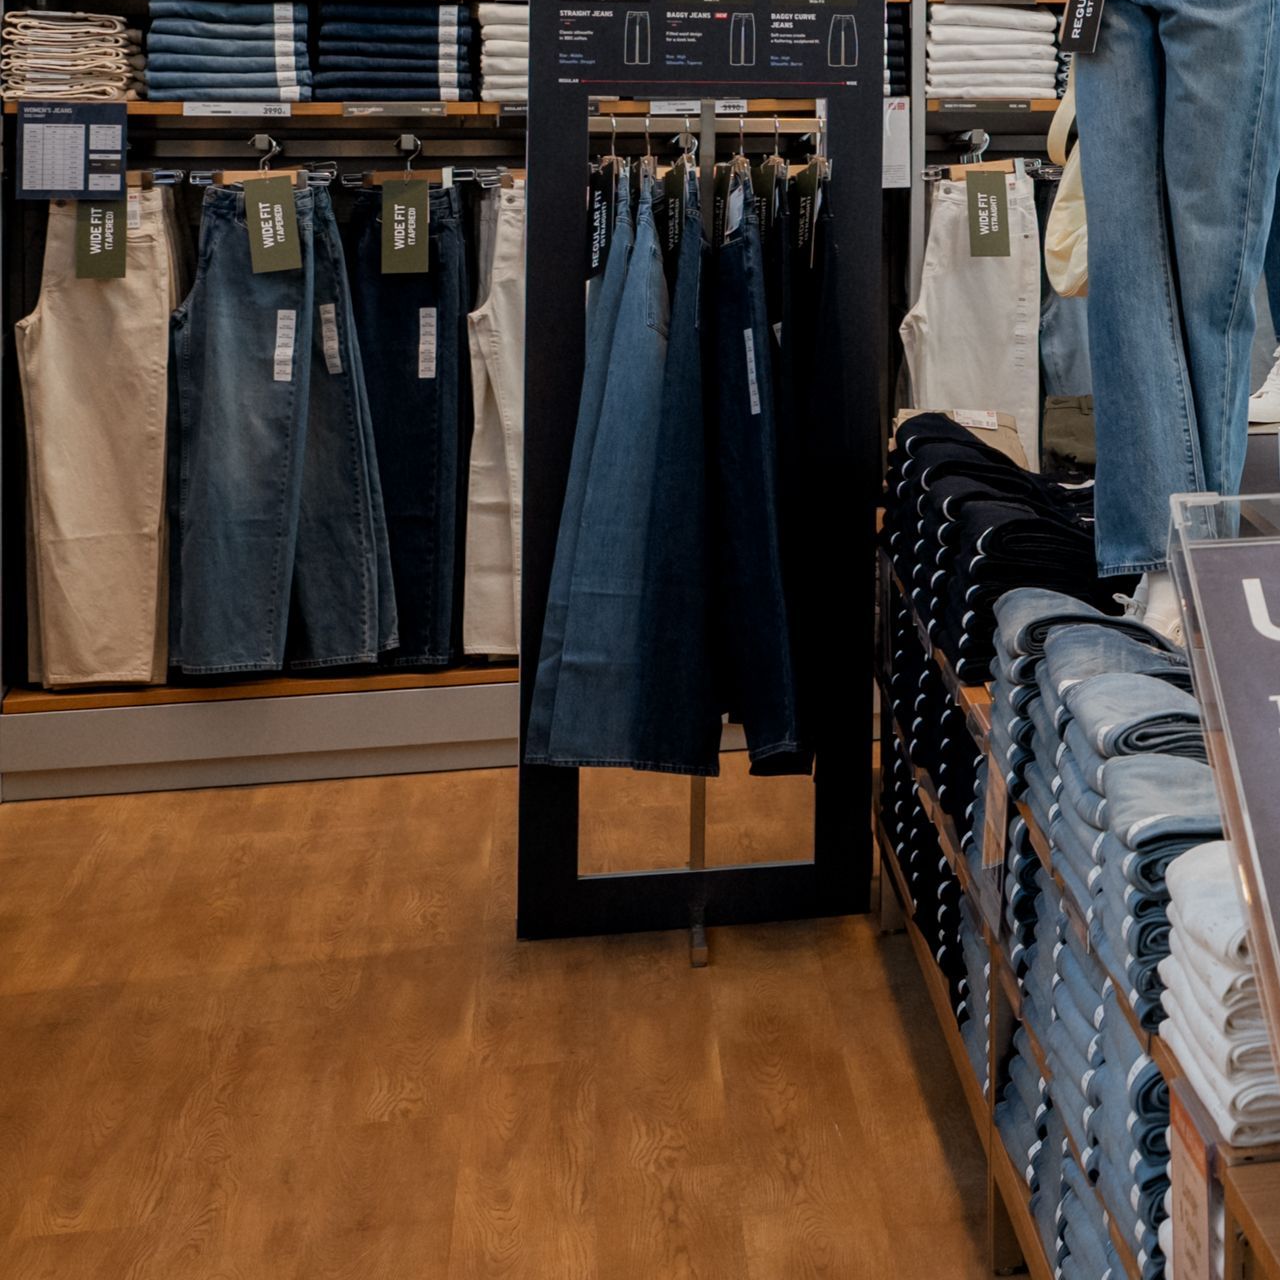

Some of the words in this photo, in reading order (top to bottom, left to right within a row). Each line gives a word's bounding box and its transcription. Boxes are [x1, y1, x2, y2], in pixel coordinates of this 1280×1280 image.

[666, 11, 688, 19] BAGGY
[258, 202, 270, 218] FIT
[393, 204, 406, 221] FIT
[594, 190, 602, 207] FIT
[978, 192, 988, 207] FIT
[90, 207, 102, 224] FIT
[274, 204, 286, 242] (TAPERED)
[407, 207, 417, 246] (TAPERED)
[979, 209, 990, 235] WIDE
[990, 195, 998, 232] (STRAIGHT)
[89, 225, 103, 255] WIDE
[104, 211, 114, 250] (TAPERED)
[260, 220, 275, 248] WIDE
[394, 222, 407, 250] WIDE
[591, 208, 602, 268] REGULAR
